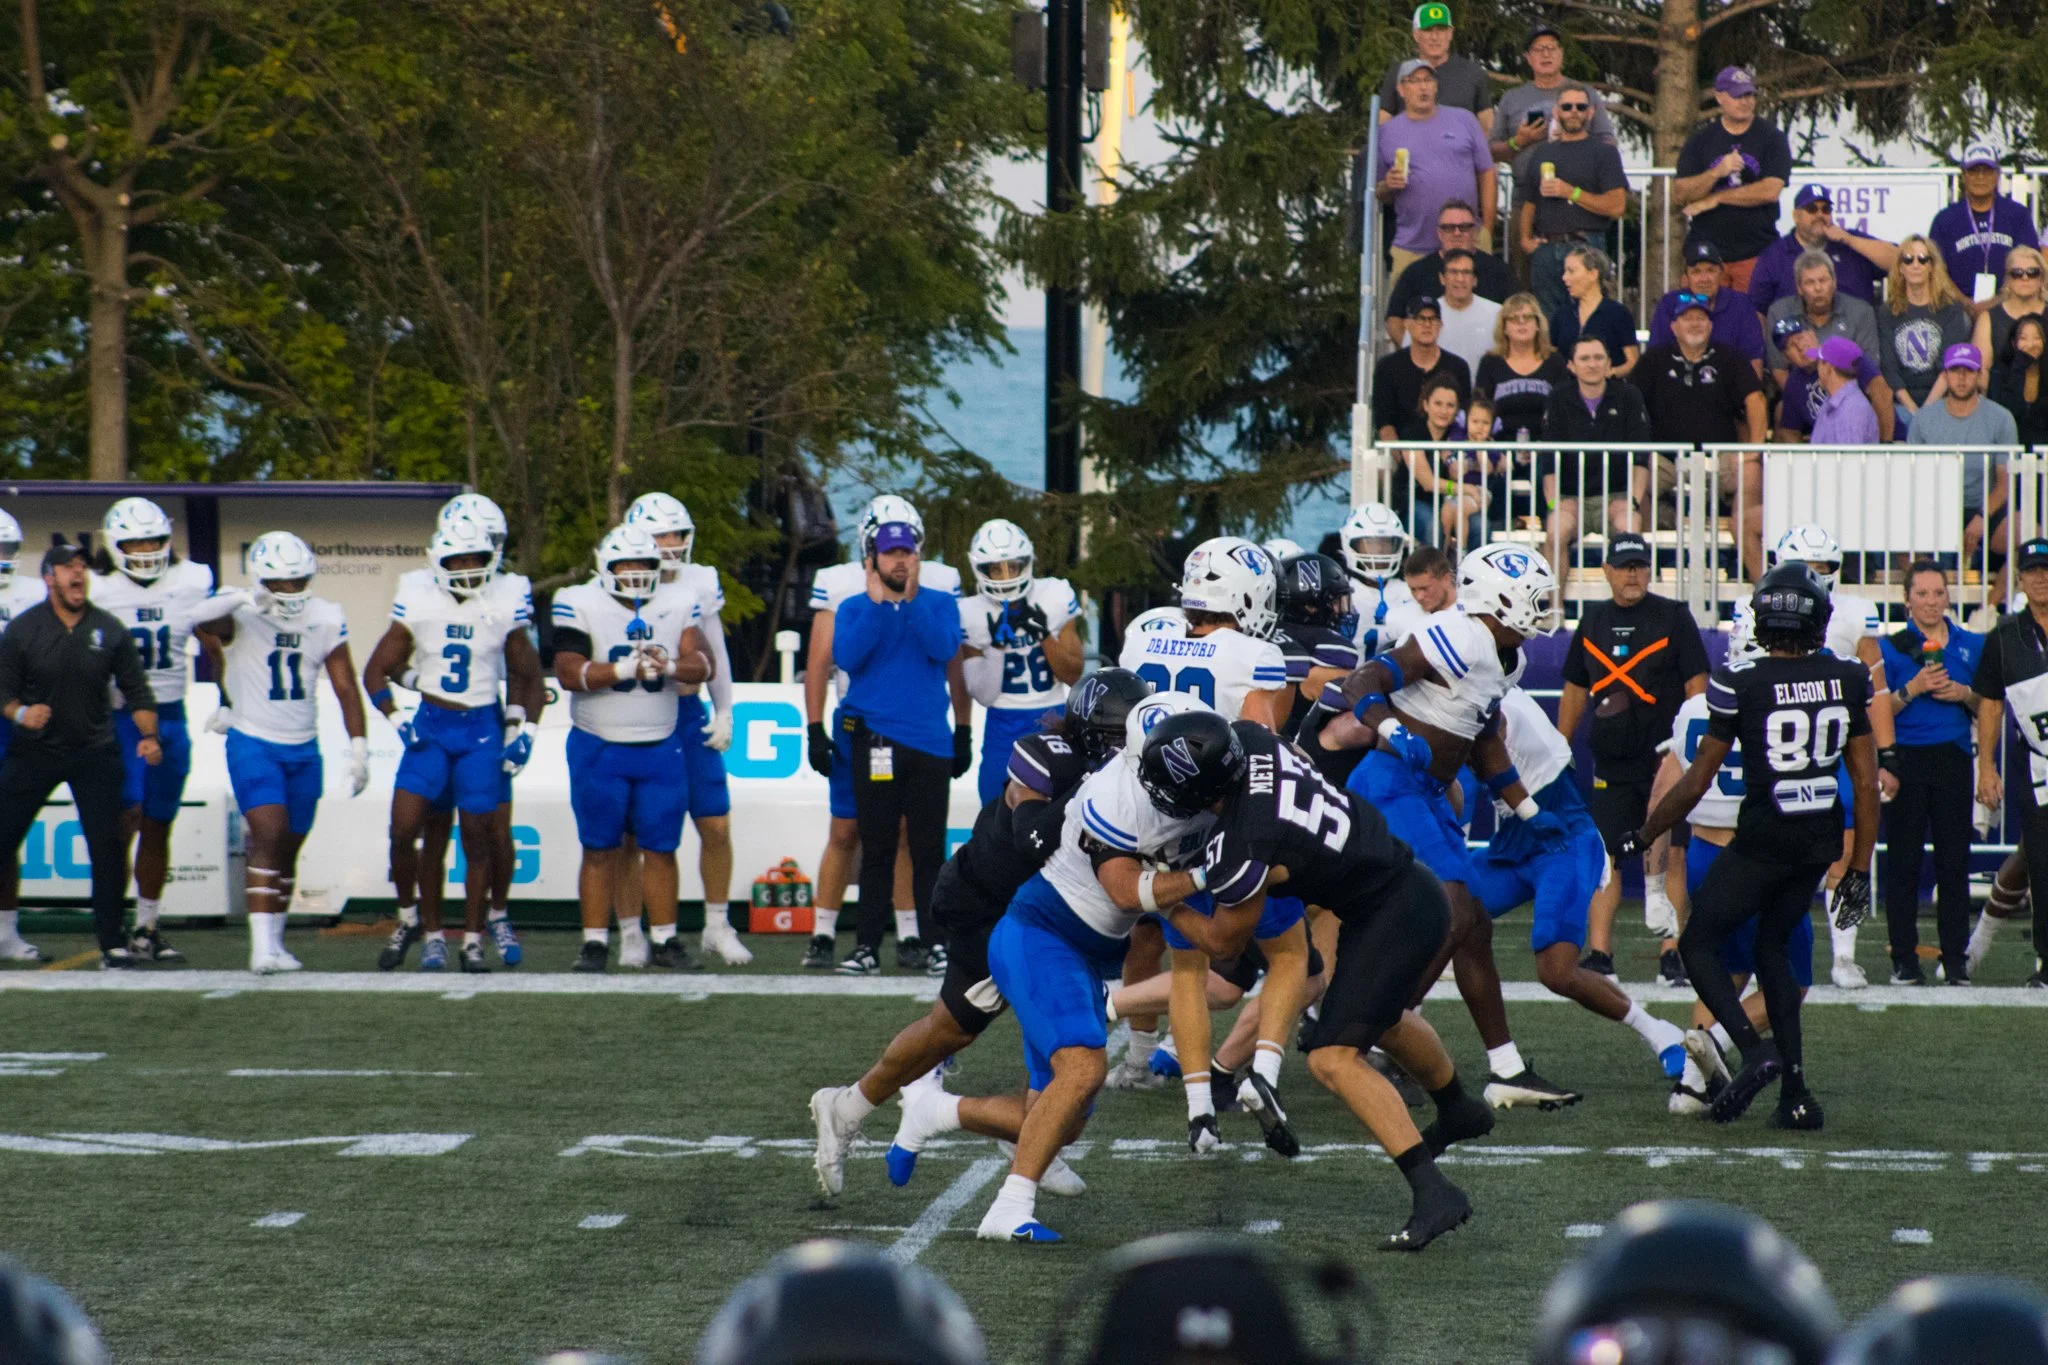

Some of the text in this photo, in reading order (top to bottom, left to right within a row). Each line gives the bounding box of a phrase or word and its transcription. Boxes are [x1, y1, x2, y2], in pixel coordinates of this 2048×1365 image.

[1834, 187, 1890, 214] AST
[1906, 330, 1929, 362] N
[318, 561, 383, 576] edicine
[275, 633, 301, 649] EIU
[446, 623, 473, 640] EIU
[1145, 637, 1217, 658] DRAKEFORD
[267, 652, 306, 701] 11
[440, 643, 471, 693] 3
[1001, 646, 1056, 695] 26
[1774, 678, 1844, 705] ELIGON II
[1766, 705, 1850, 773] 80
[1160, 736, 1200, 784] N
[1249, 753, 1274, 795] METZ
[1277, 742, 1351, 854] 57
[1800, 785, 1813, 803] N
[1205, 830, 1226, 873] 57
[775, 910, 793, 930] G
